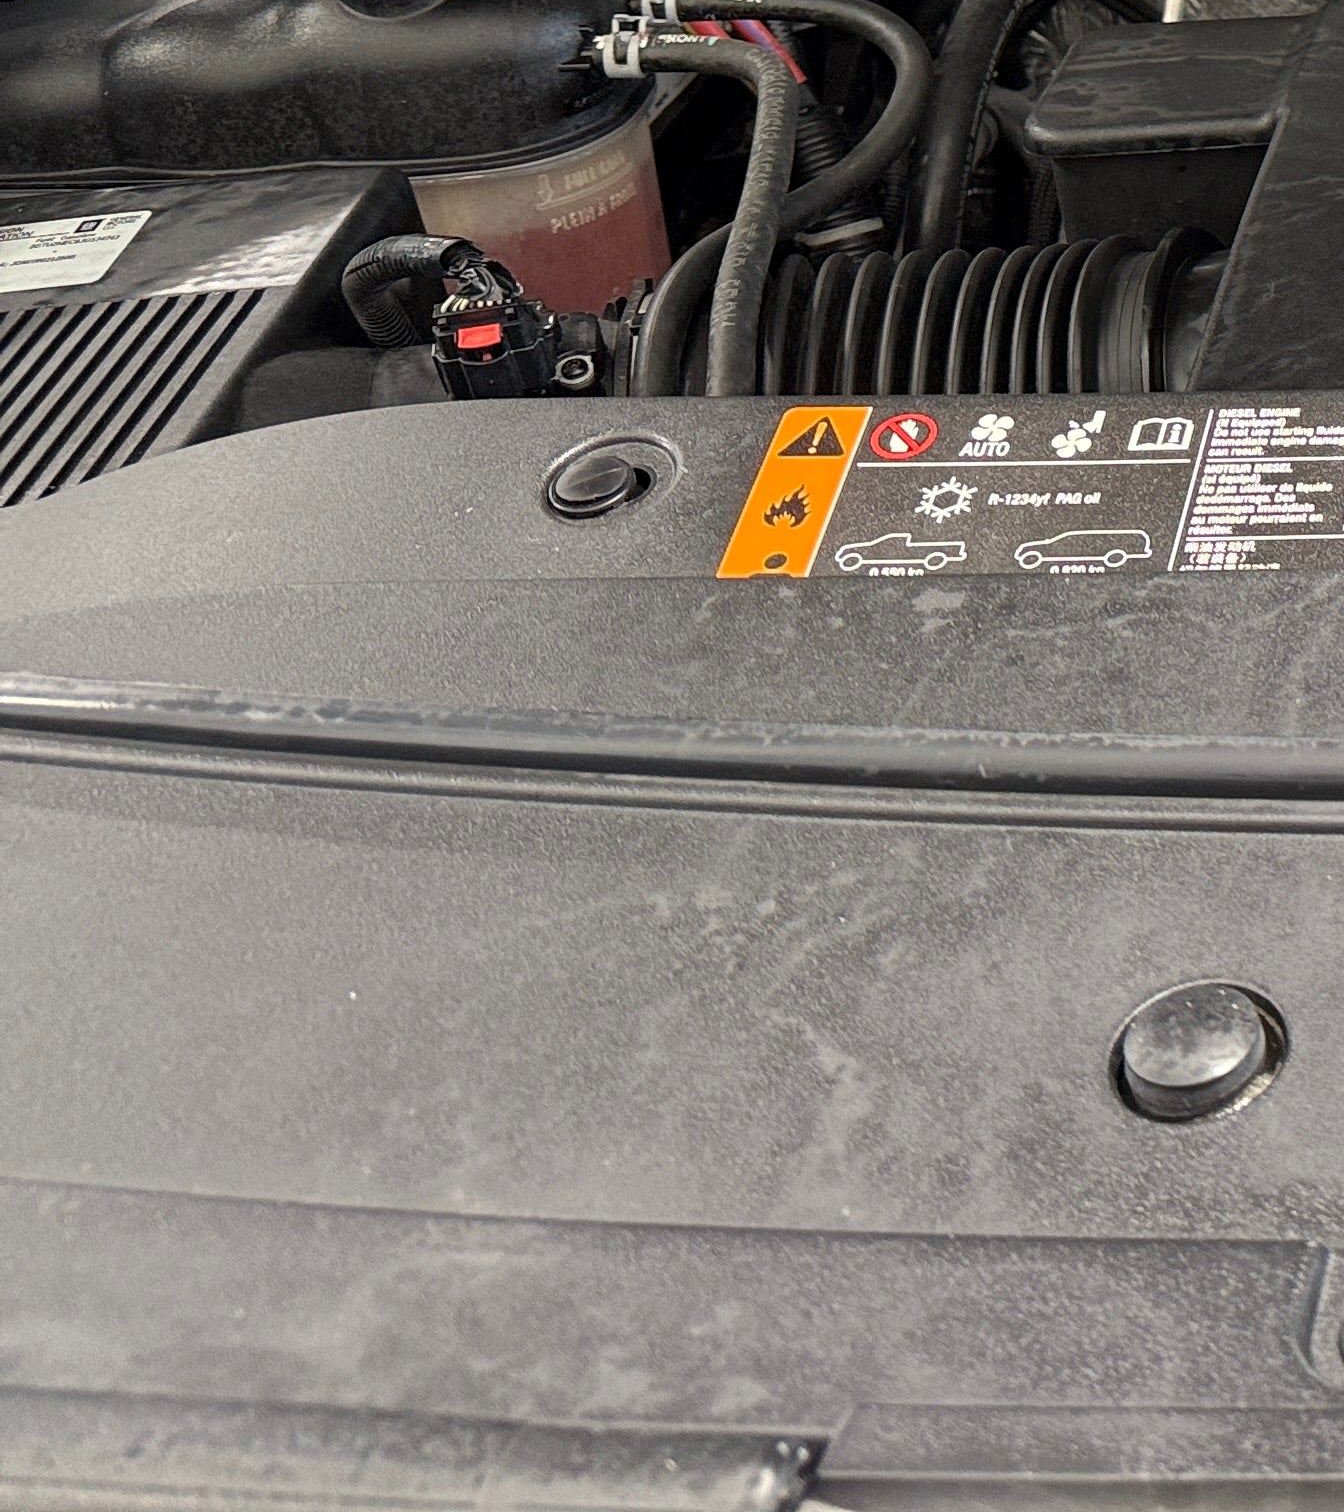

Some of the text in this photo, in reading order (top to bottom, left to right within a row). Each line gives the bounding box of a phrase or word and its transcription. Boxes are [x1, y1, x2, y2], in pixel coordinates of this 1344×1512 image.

[1218, 407, 1301, 417] DIESEL ENGINE
[1231, 428, 1249, 436] not
[1273, 427, 1314, 437] starting
[1270, 437, 1307, 447] engine
[959, 441, 1010, 457] AUTO
[1208, 448, 1229, 456] can
[1204, 463, 1293, 473] MOTEUR DIESEL
[1199, 485, 1214, 494] Ne
[1216, 486, 1237, 495] pas
[1279, 483, 1294, 492] de
[1296, 482, 1333, 494] liquide
[988, 492, 1101, 505] R-1234yf PAG oil
[1274, 493, 1296, 502] Des
[1190, 516, 1205, 525] au
[1207, 515, 1248, 524] moteur
[1309, 514, 1324, 522] en
